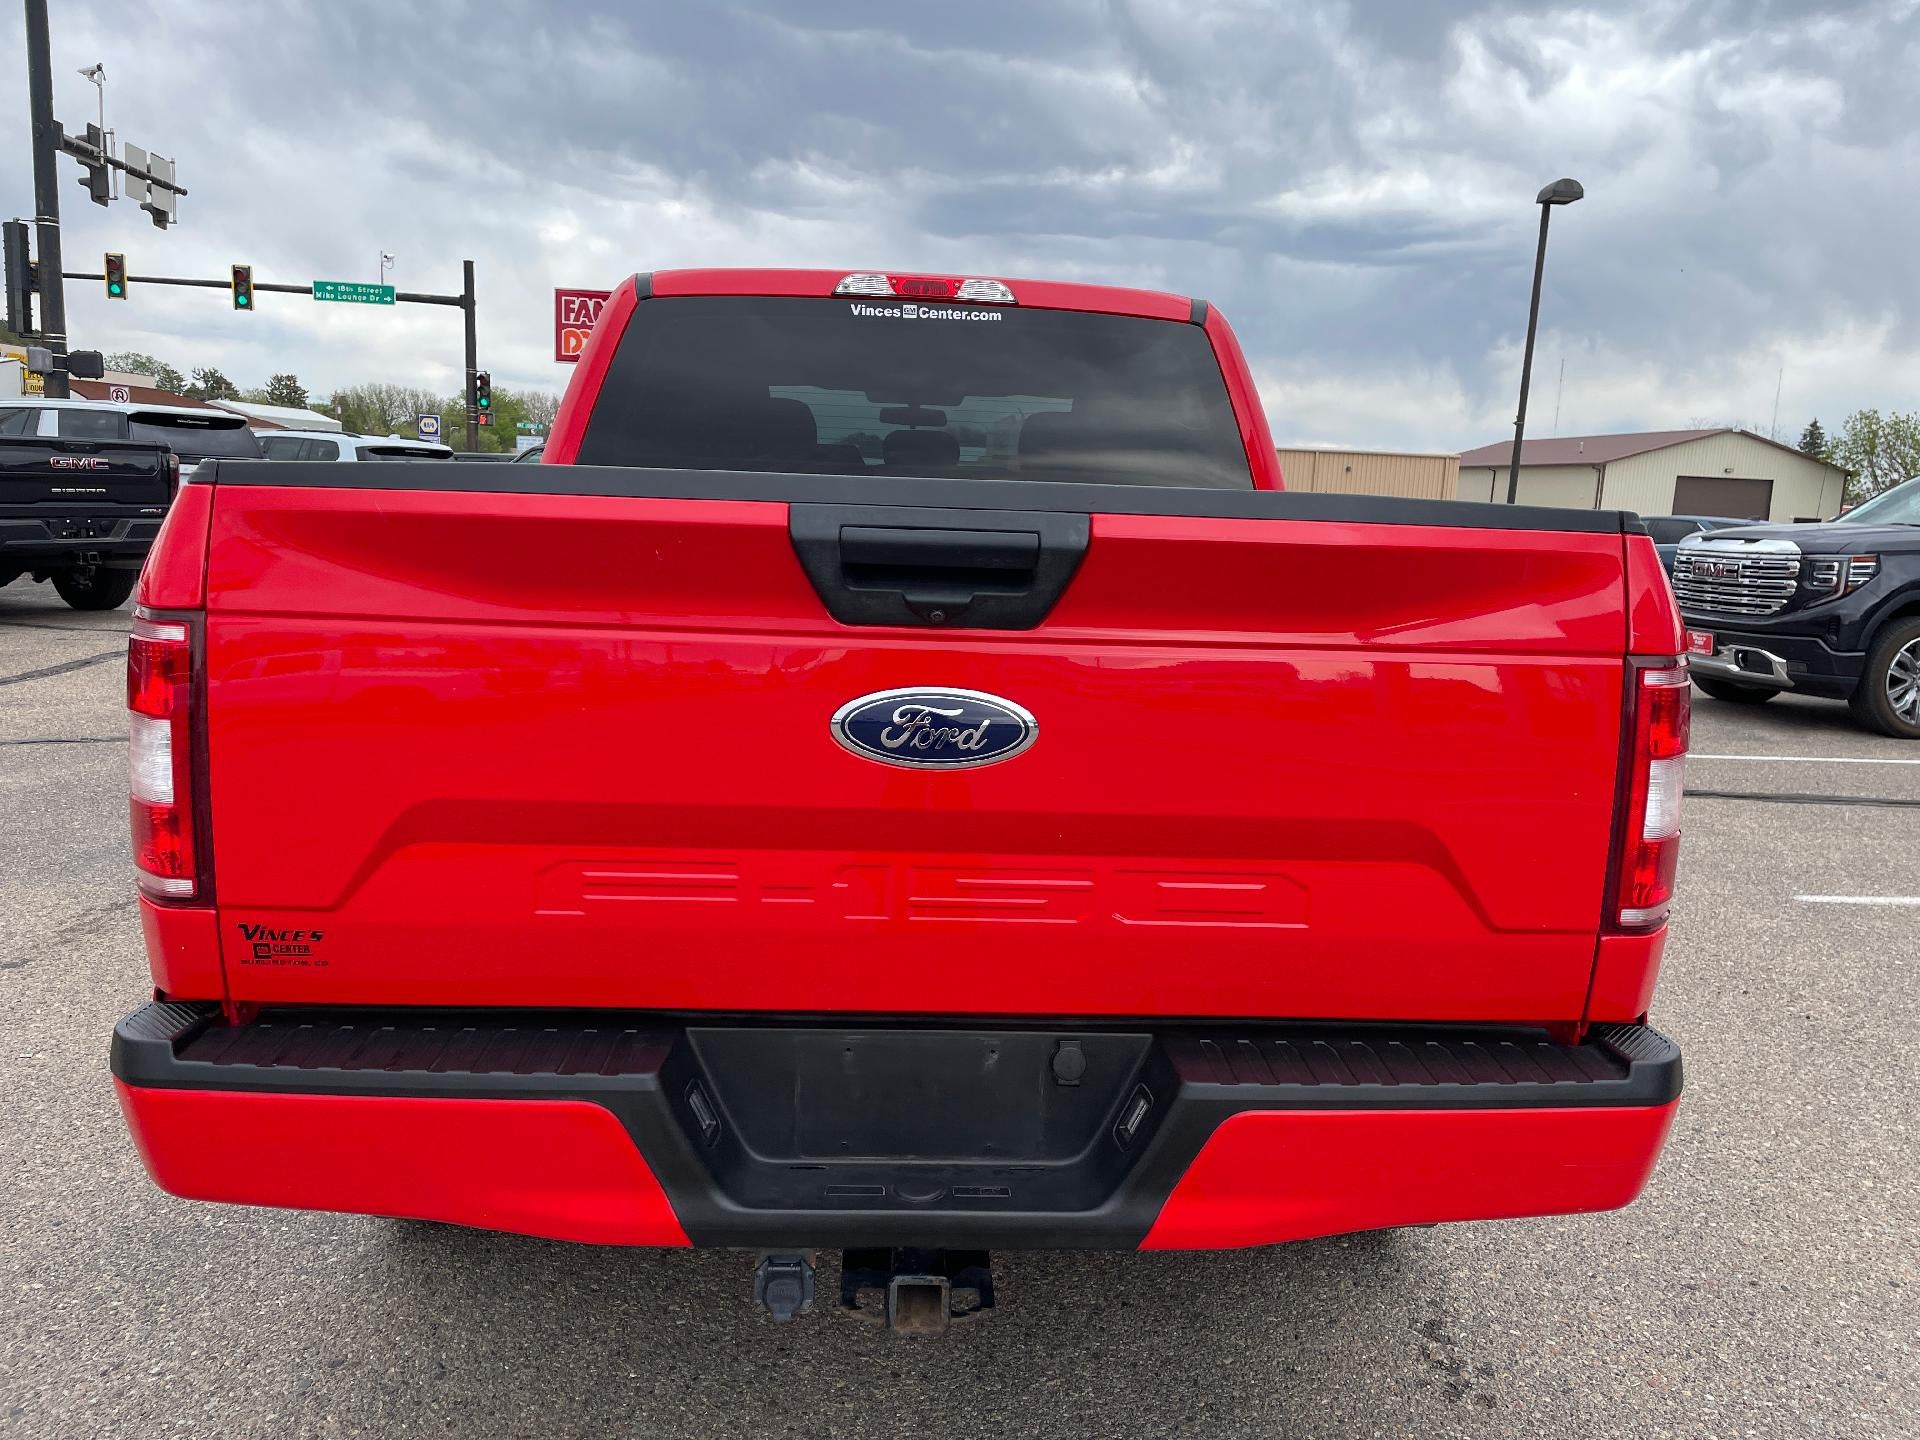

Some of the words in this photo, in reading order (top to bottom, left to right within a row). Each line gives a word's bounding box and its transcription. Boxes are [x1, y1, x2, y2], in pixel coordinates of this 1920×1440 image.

[315, 291, 335, 299] Mike
[337, 293, 367, 302] Lounge
[357, 286, 383, 294] Street
[850, 303, 901, 317] Vinces
[918, 306, 1002, 321] Center.com
[51, 456, 109, 470] GMC
[1693, 561, 1738, 577] GMC
[880, 704, 991, 751] Ford
